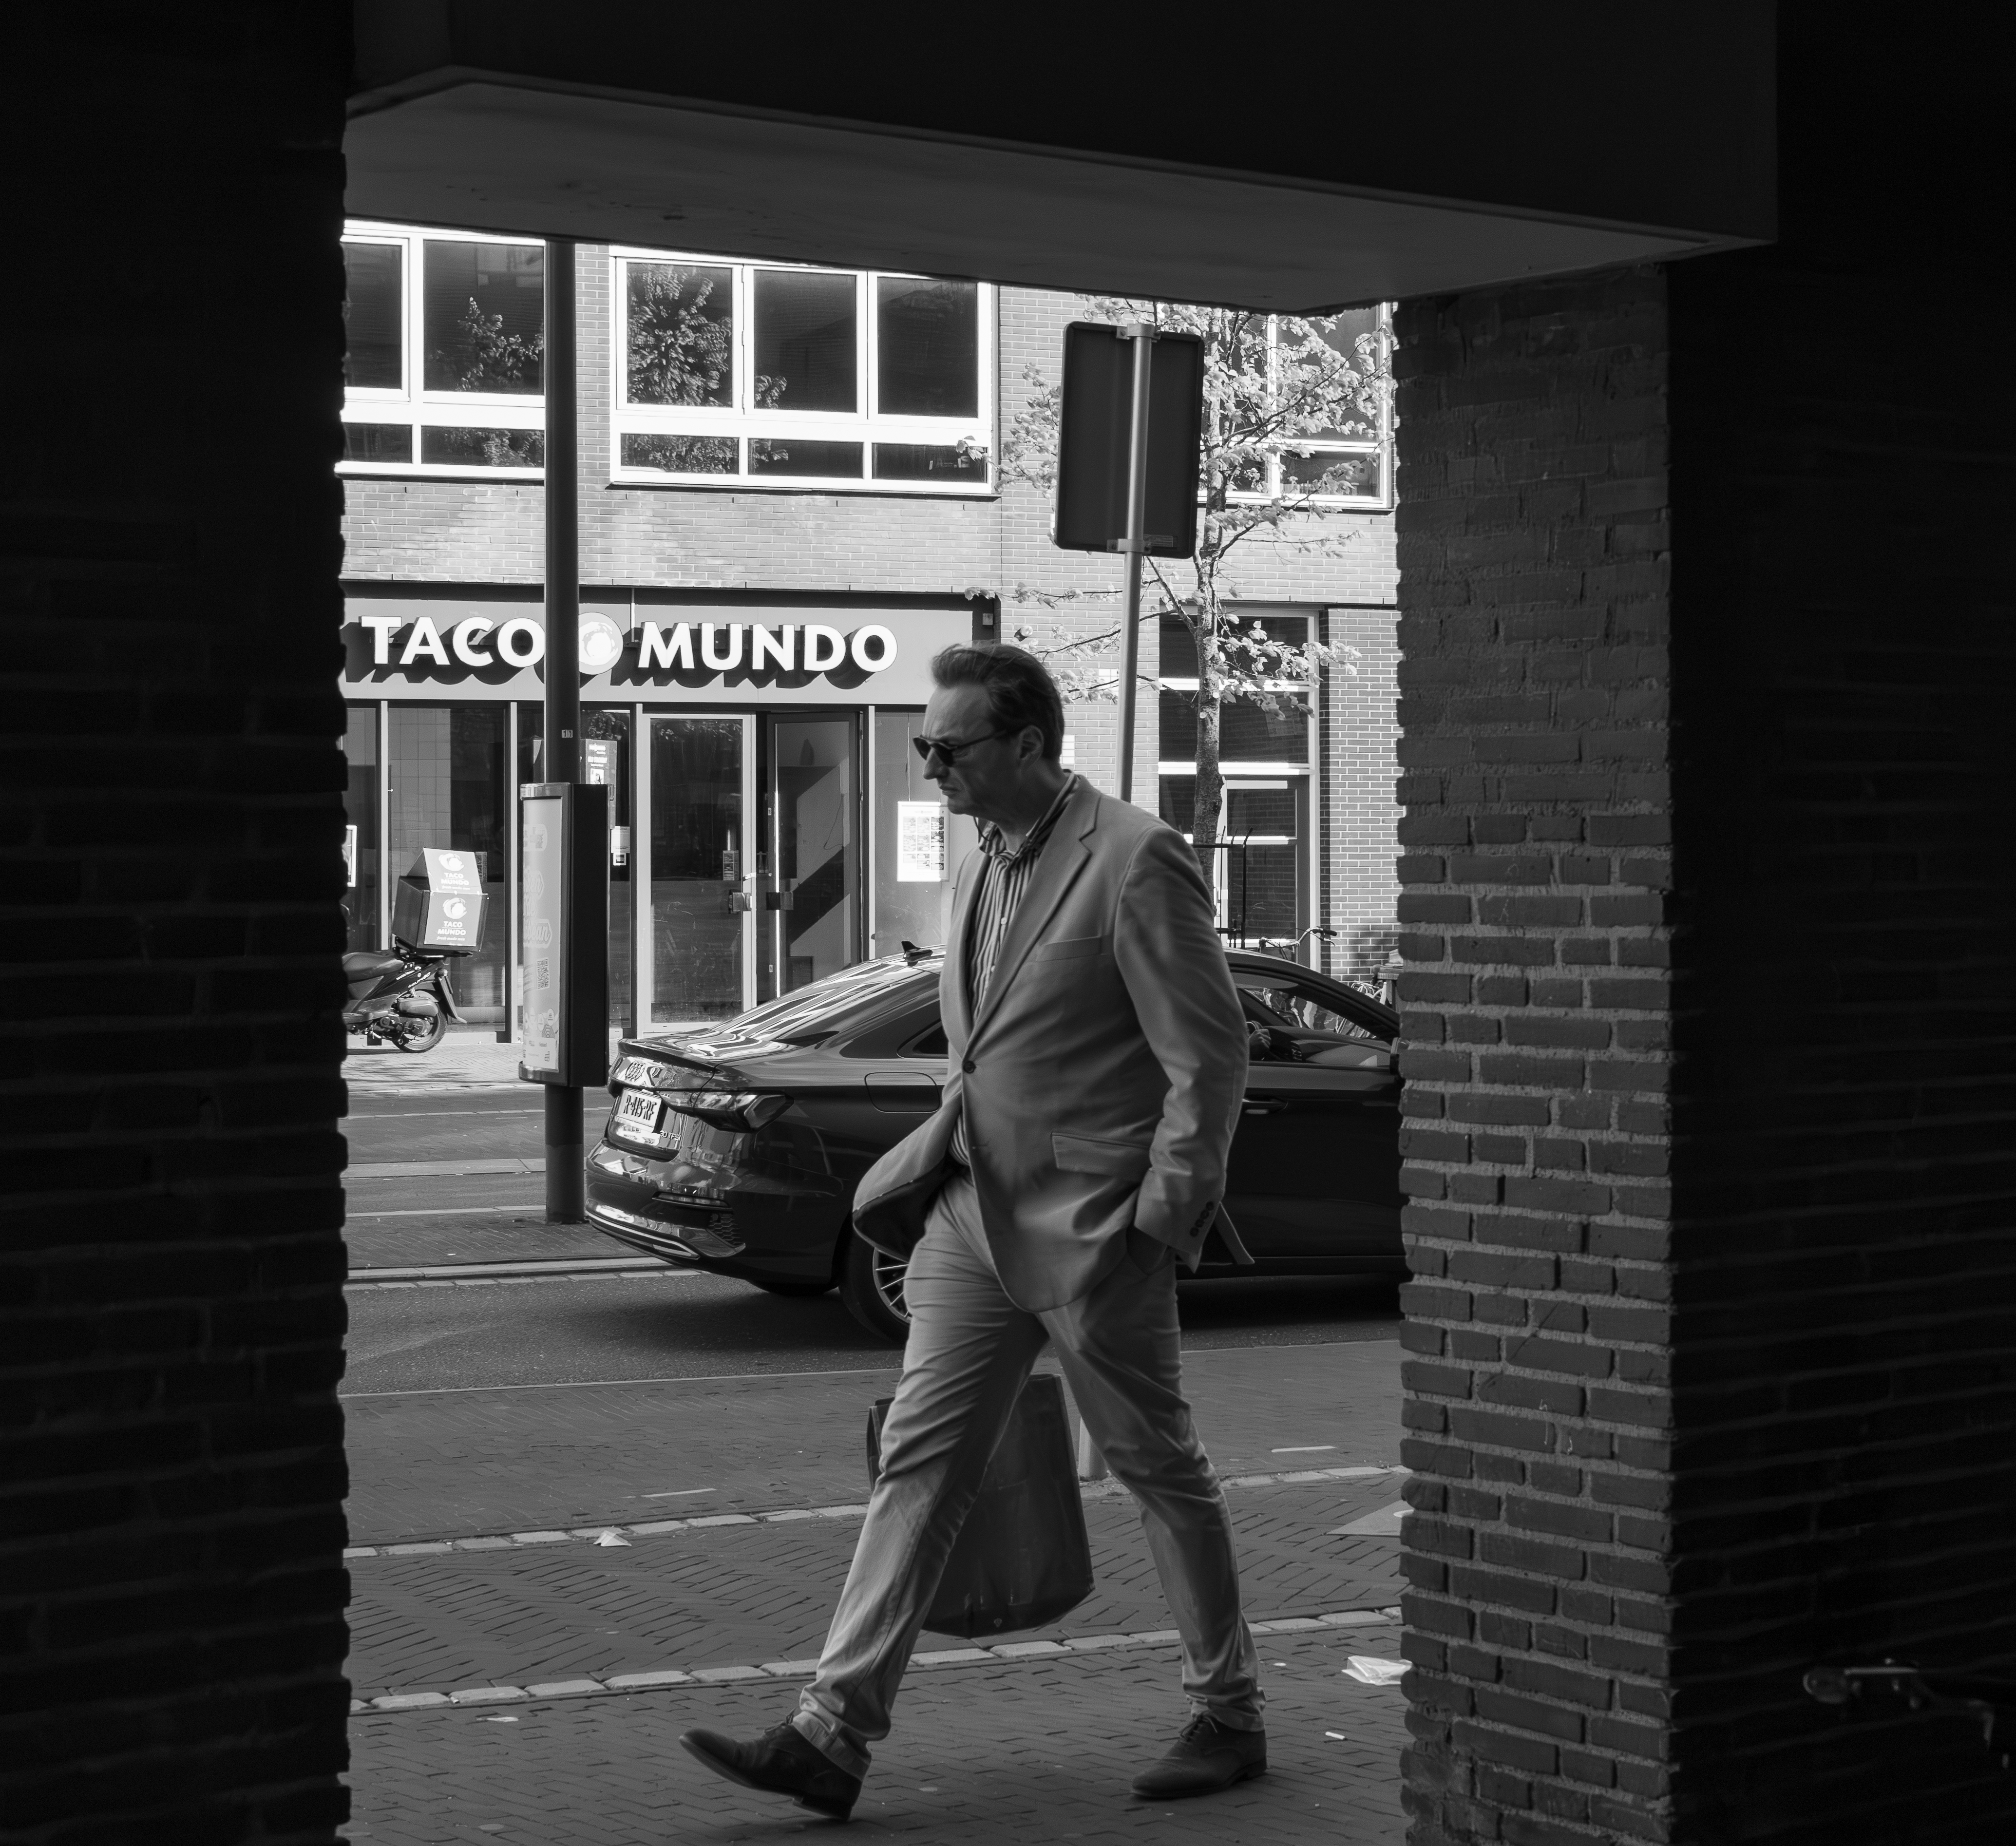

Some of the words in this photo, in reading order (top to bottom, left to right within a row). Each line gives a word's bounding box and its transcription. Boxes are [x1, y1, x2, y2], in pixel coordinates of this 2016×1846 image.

[359, 615, 545, 667] TACO
[638, 621, 898, 672] MUNDO
[668, 1132, 681, 1141] TFSI
